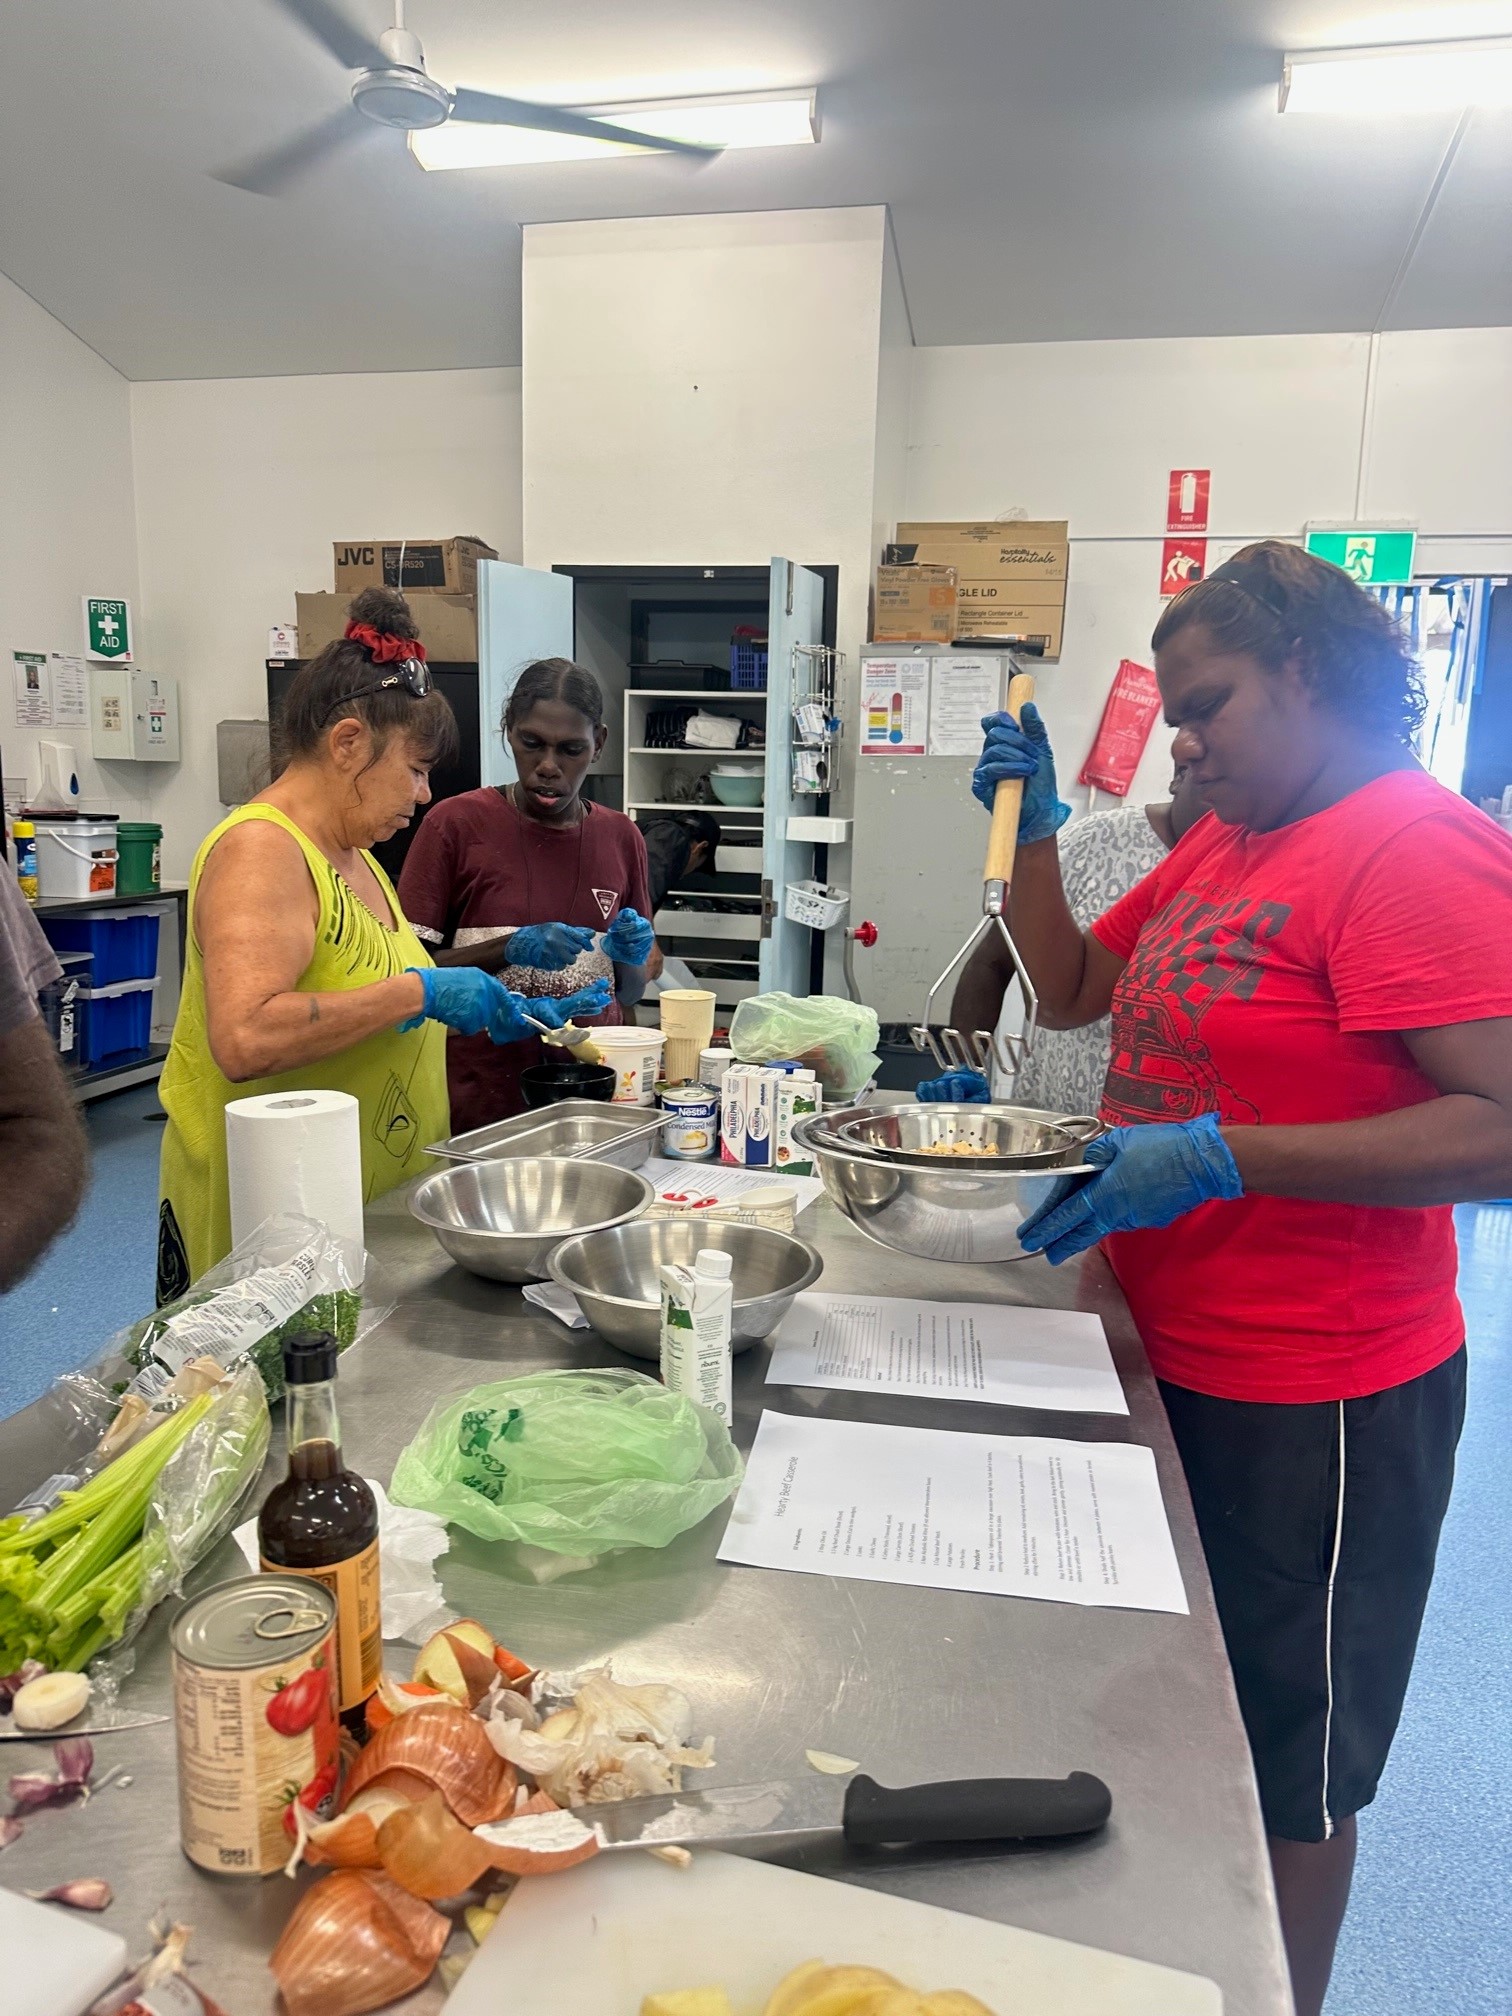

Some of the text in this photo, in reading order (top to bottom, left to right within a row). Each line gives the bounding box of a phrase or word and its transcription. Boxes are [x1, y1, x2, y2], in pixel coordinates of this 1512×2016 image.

[338, 547, 374, 566] JVC
[1000, 551, 1056, 563] essentials
[959, 588, 997, 597] GLE LID
[90, 602, 124, 614] FIRST
[100, 636, 120, 647] AID
[1128, 690, 1159, 706] BLANKET
[667, 1121, 705, 1130] Condensed
[729, 1100, 738, 1139] PHILADELPHIA
[775, 1457, 798, 1516] Hearty Beef Casserole
